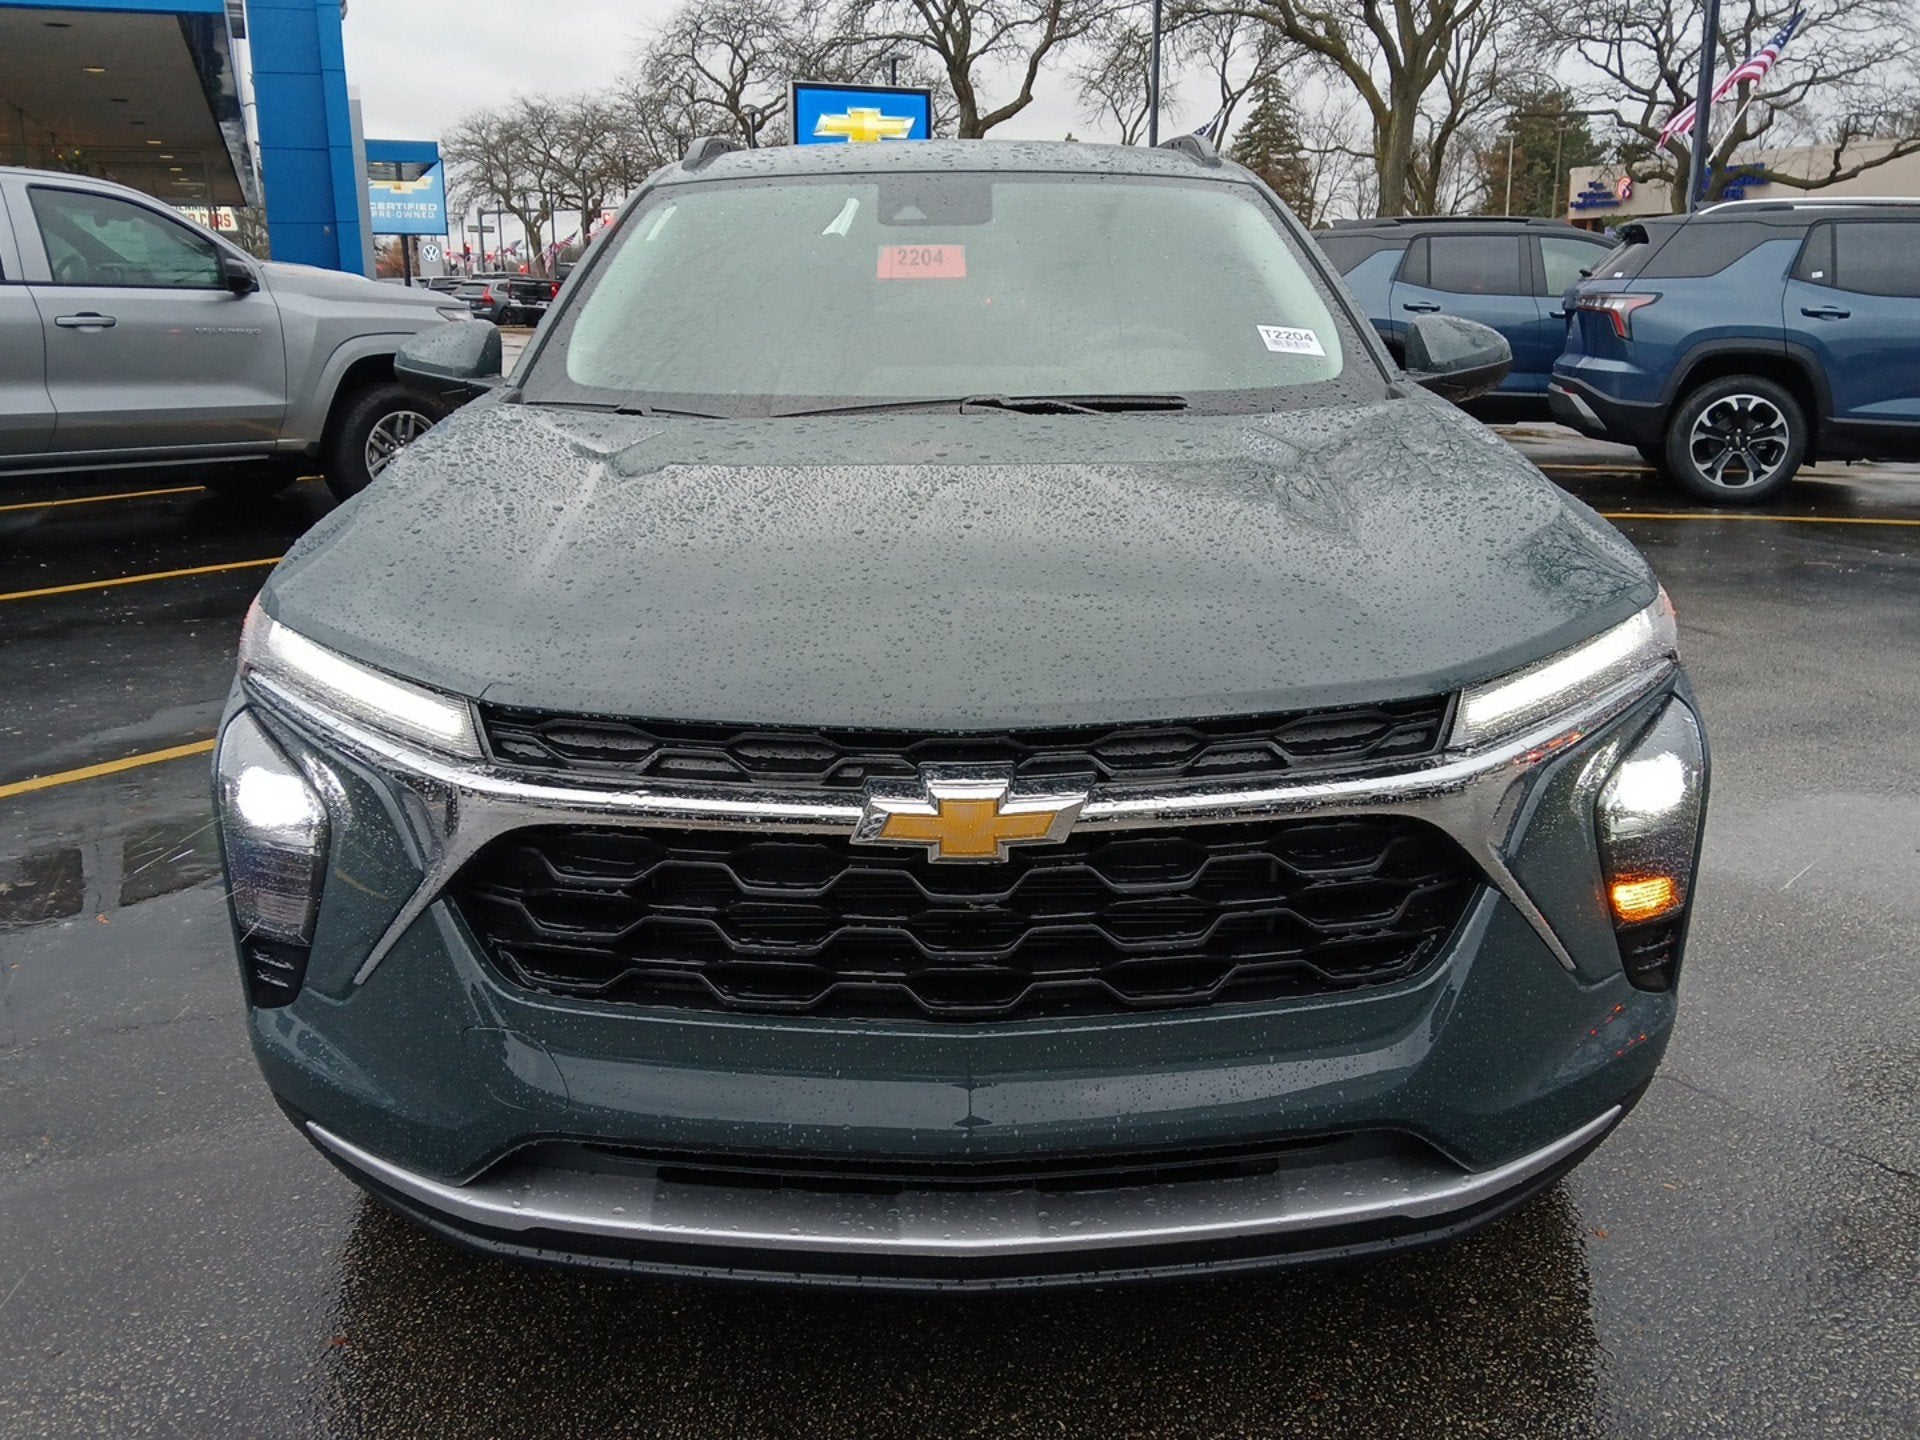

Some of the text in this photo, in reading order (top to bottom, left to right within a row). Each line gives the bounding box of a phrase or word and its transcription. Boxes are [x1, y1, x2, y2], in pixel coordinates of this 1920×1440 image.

[370, 202, 436, 211] CERTIFIED
[200, 212, 231, 228] CRS
[897, 248, 943, 266] 2204
[1262, 329, 1313, 341] T2204
